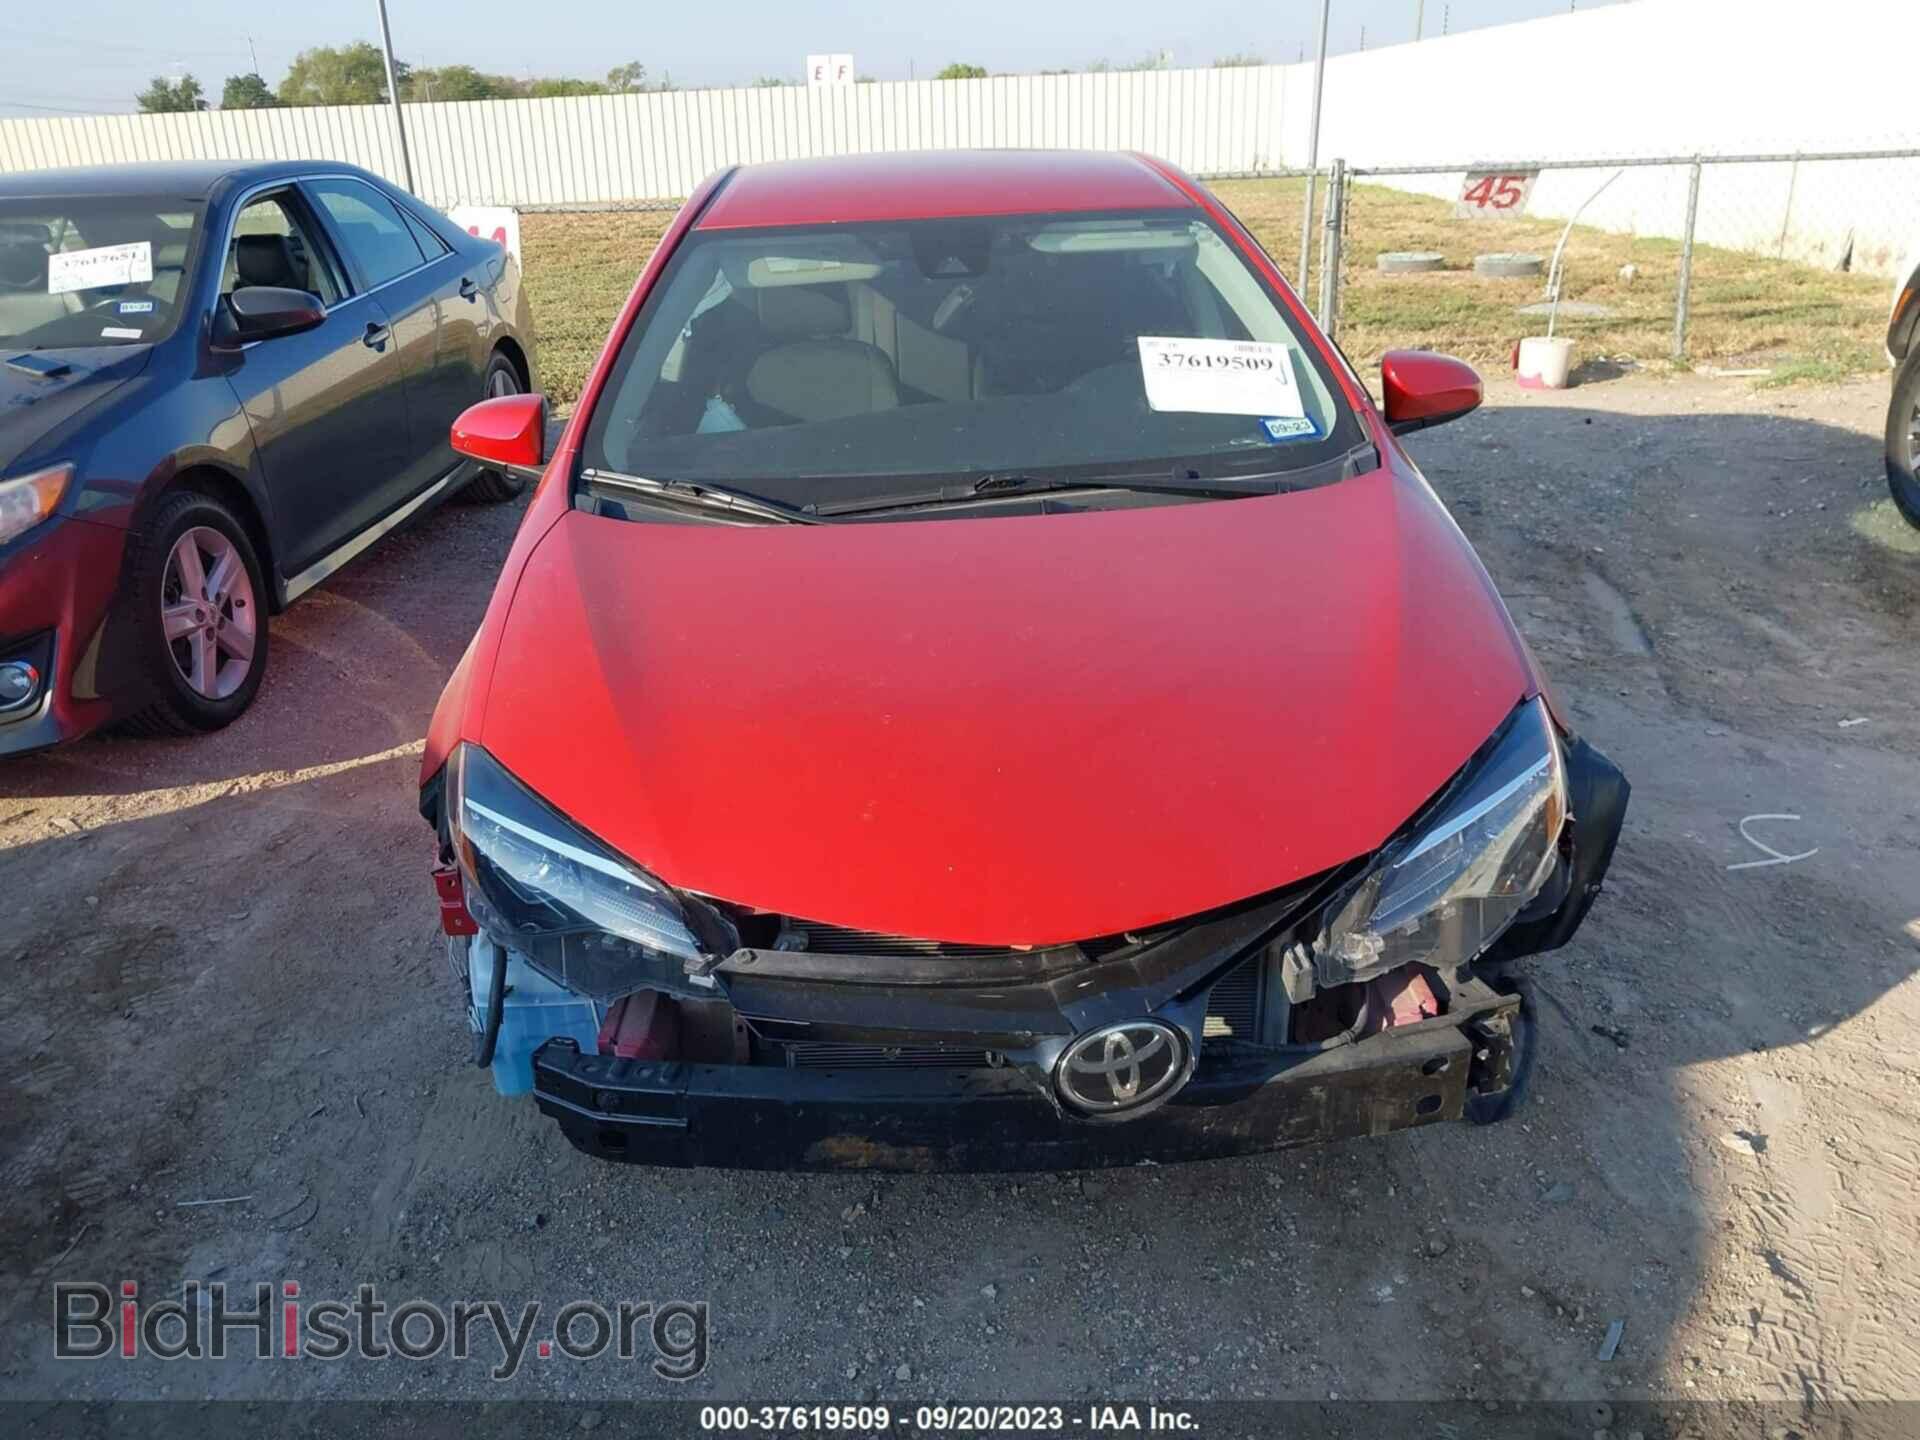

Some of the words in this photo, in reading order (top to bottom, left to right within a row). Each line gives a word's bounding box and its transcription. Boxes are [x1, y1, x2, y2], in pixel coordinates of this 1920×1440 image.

[814, 65, 824, 81] E
[838, 64, 848, 81] F
[1463, 175, 1529, 209] 45
[1158, 352, 1274, 371] 37619509
